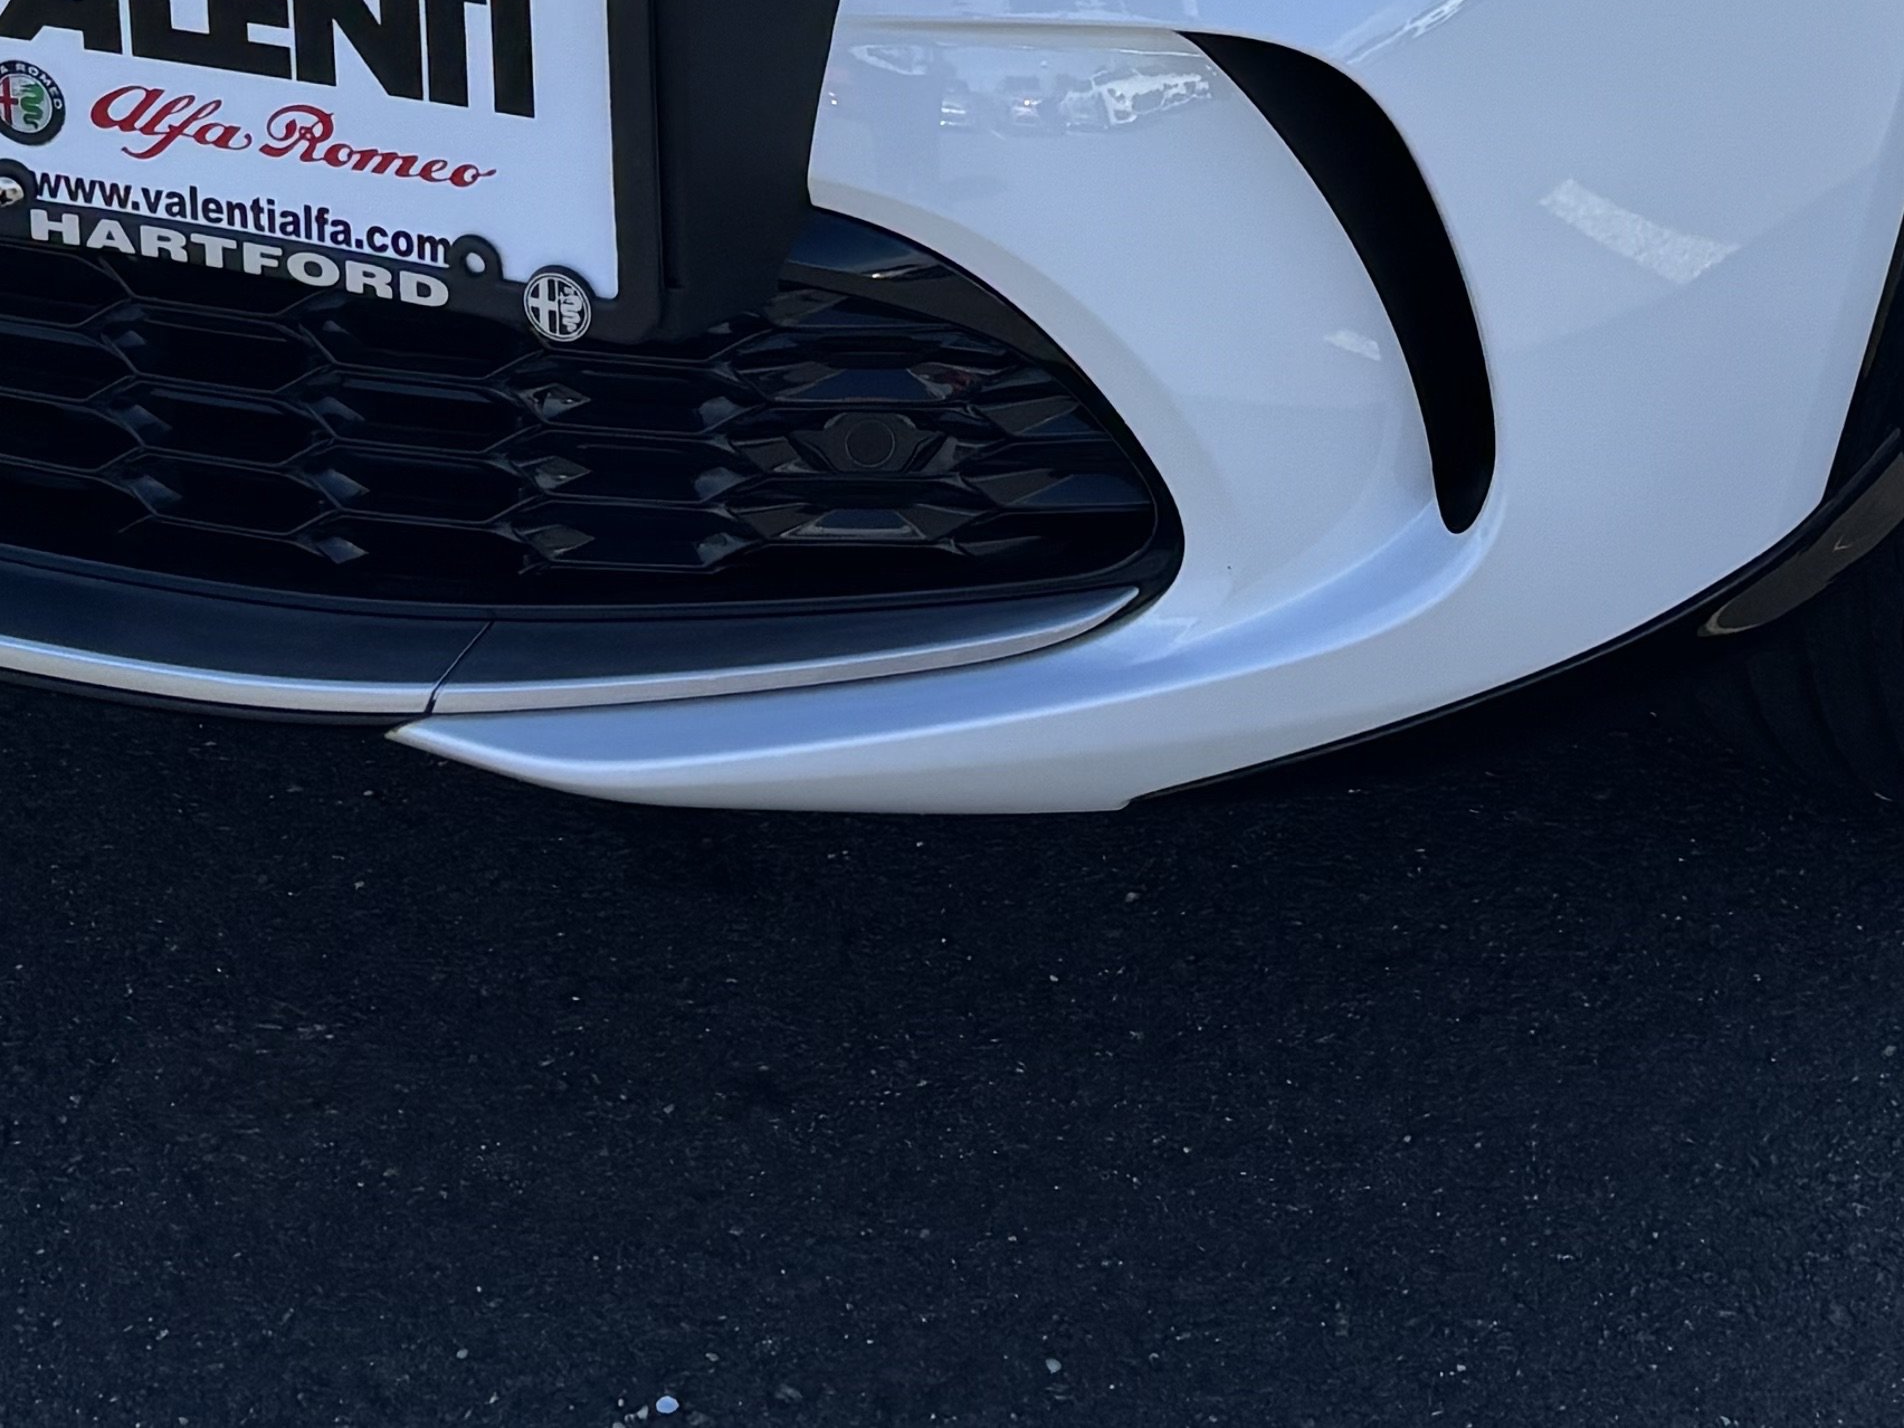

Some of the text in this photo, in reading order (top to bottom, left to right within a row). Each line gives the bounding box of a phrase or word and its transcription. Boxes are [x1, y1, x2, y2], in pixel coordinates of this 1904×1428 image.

[15, 63, 63, 110] ROMEO
[90, 85, 497, 188] Alfa Romeo
[29, 208, 450, 307] HARTFORD
[30, 170, 453, 264] www.valentialfa.com
